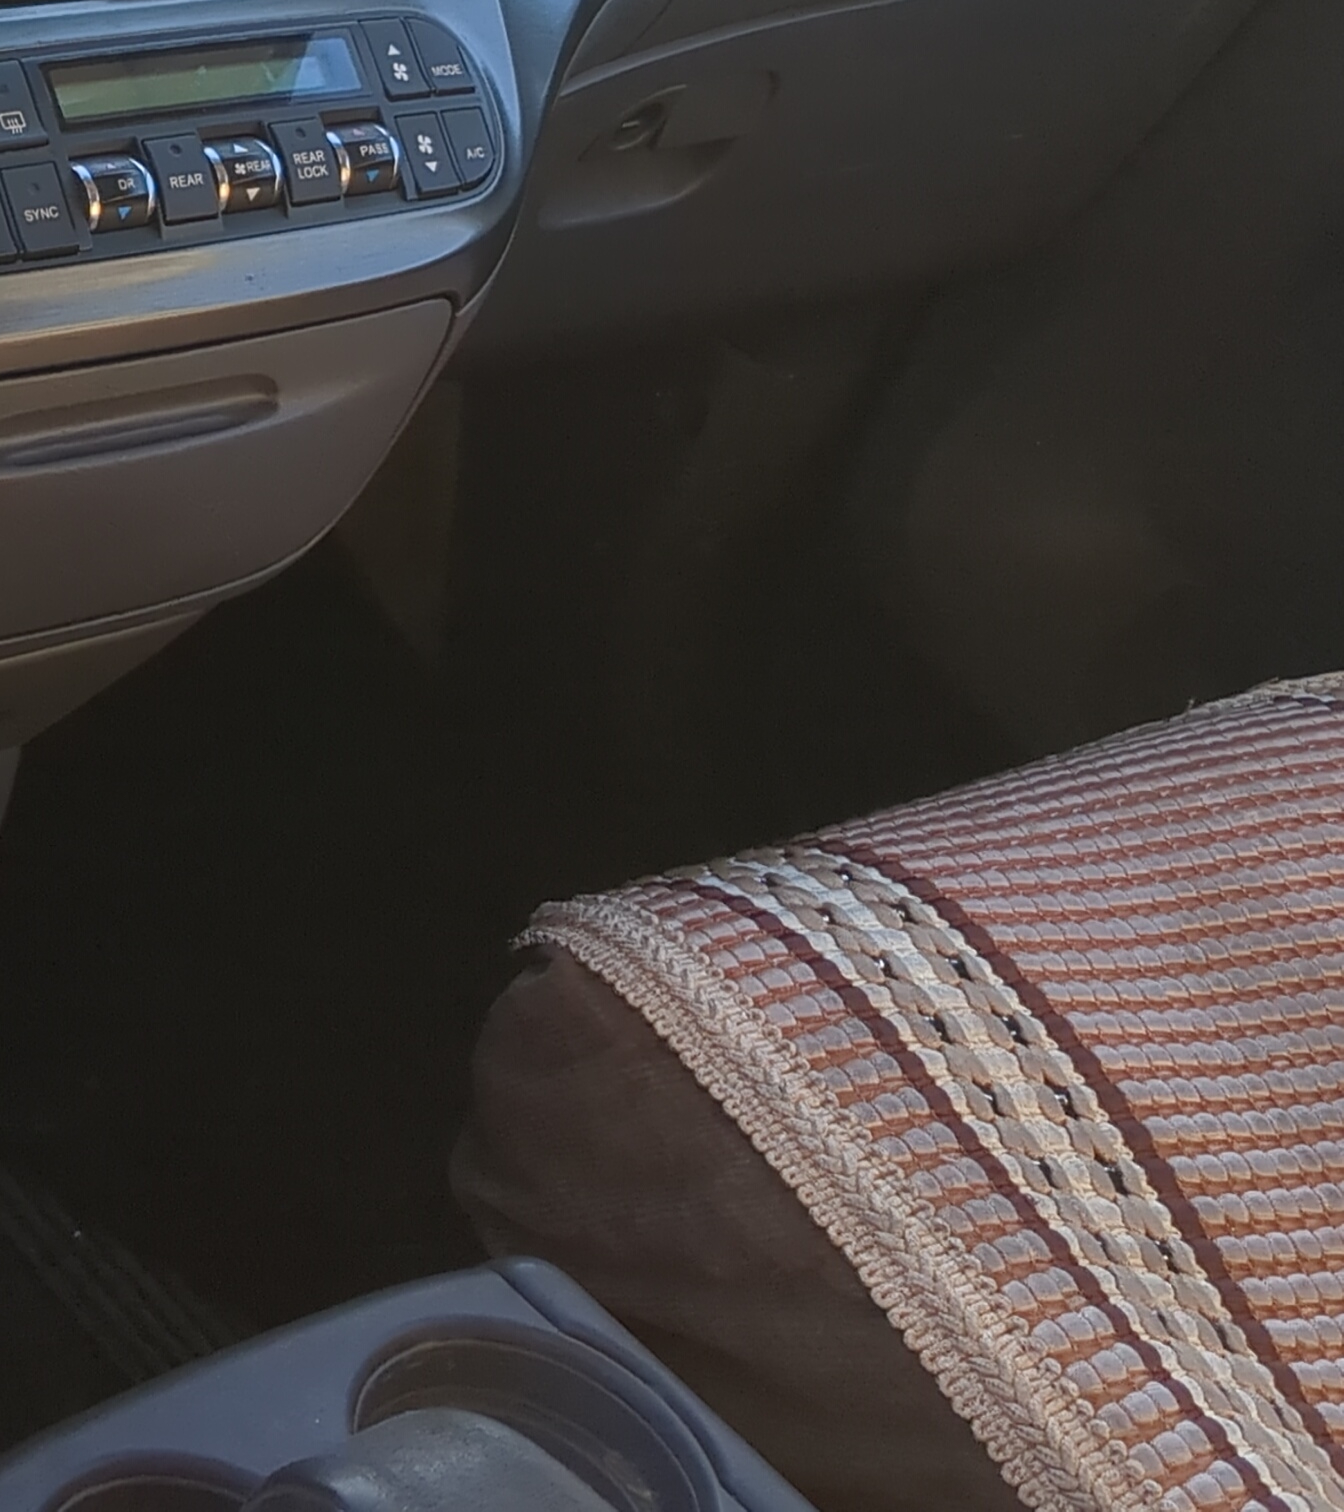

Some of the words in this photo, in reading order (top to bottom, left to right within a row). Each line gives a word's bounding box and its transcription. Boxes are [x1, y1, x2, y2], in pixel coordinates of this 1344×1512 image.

[431, 63, 462, 77] MODE
[360, 142, 389, 157] PASS
[467, 147, 485, 160] A/C
[293, 150, 325, 165] REAR
[247, 159, 272, 173] REAR
[297, 164, 329, 180] LOCK
[118, 178, 136, 191] DR
[169, 172, 204, 189] REAR
[24, 205, 60, 222] SYNC
